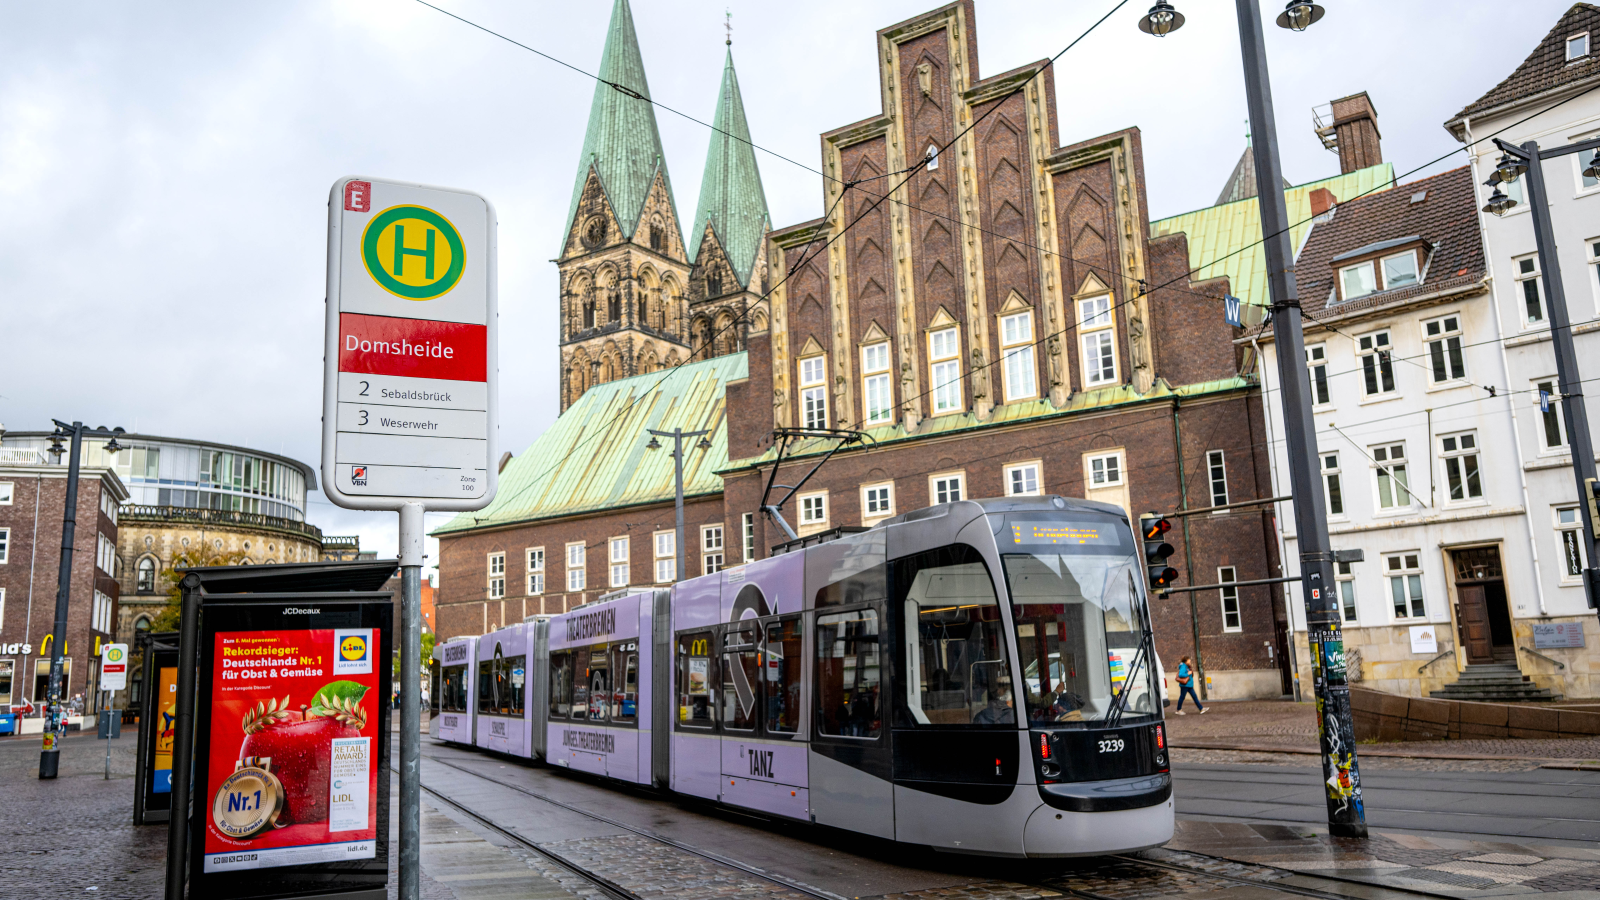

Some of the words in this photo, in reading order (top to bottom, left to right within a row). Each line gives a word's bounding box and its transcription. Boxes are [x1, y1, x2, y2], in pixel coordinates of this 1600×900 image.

[351, 190, 363, 208] E
[393, 224, 436, 280] H
[1226, 298, 1240, 322] W
[346, 334, 454, 358] Domsheide
[359, 380, 370, 396] 2
[381, 389, 452, 402] Sebaldsbrück
[1540, 394, 1548, 409] W
[358, 410, 368, 426] 3
[380, 418, 438, 430] Weserwehr
[1314, 590, 1318, 598] C
[566, 607, 616, 642] THEATERBREMEN
[0, 643, 32, 654] ld's
[112, 650, 118, 659] H
[223, 646, 298, 656] Rekordsieger:
[222, 656, 297, 668] Deutschlands
[300, 656, 315, 665] Nr.
[317, 656, 322, 664] 1
[222, 670, 239, 680] für
[241, 669, 268, 679] Obst
[269, 668, 278, 678] &
[280, 667, 323, 677] Gemüse
[1098, 739, 1125, 753] 3239
[334, 752, 364, 760] AWARD
[748, 749, 774, 778] TANZ
[332, 794, 354, 803] LIDL
